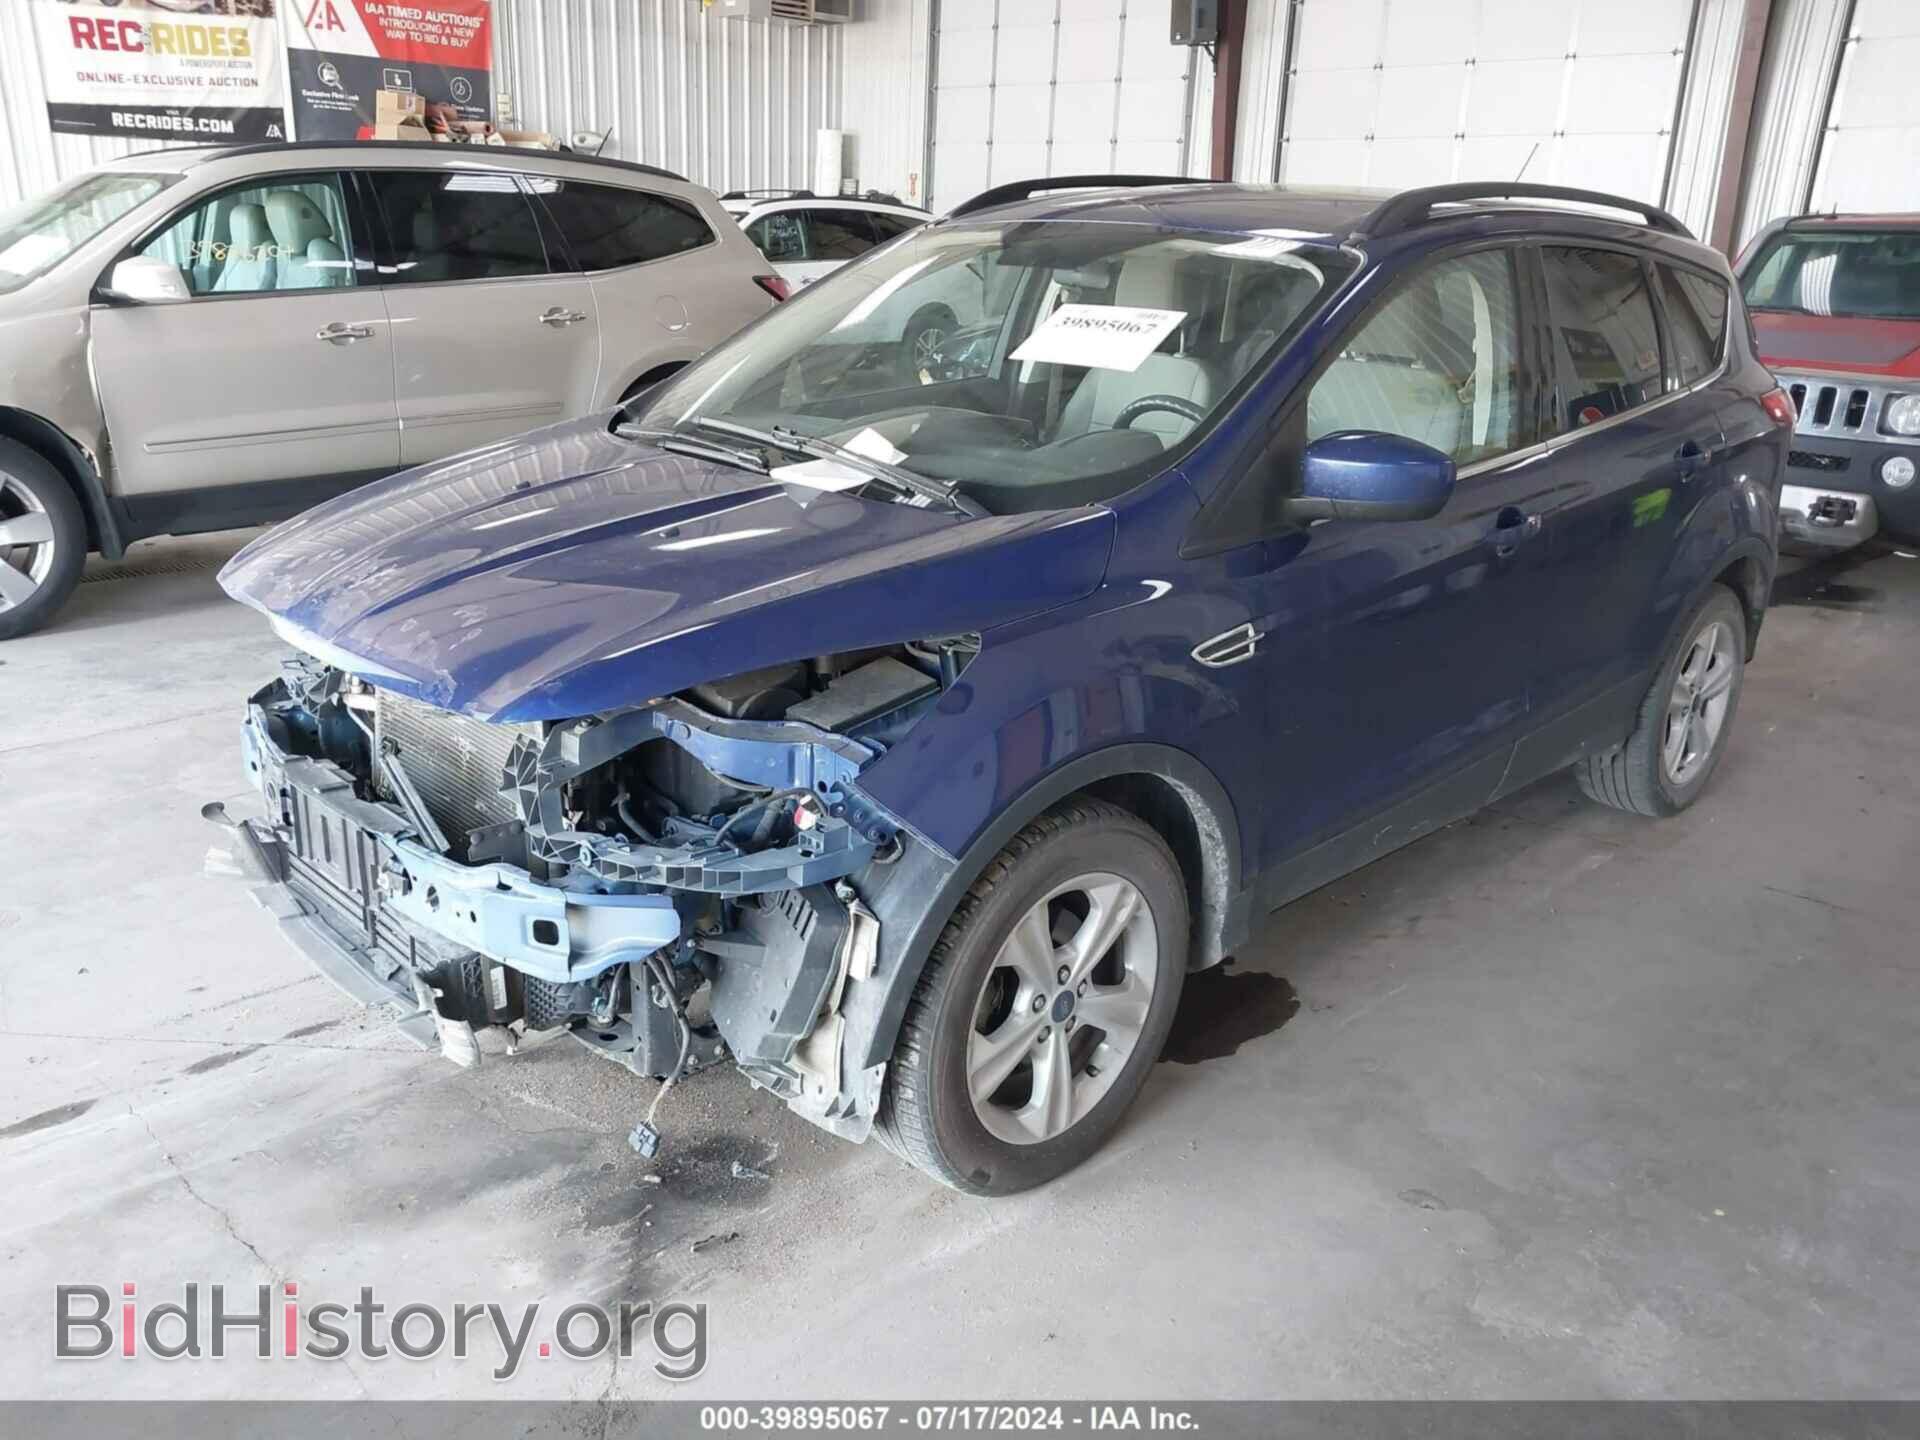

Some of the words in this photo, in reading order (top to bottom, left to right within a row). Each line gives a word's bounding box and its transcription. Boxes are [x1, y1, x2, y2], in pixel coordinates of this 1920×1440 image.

[365, 3, 384, 15] IAA
[386, 5, 422, 20] TIMED
[68, 16, 144, 53] REC
[150, 22, 252, 57] RIDES
[379, 17, 442, 34] INTRODUCING
[445, 27, 452, 35] A
[453, 28, 475, 39] NEW
[385, 29, 407, 41] WAY
[409, 32, 423, 42] TO
[450, 37, 470, 49] BUY
[76, 71, 203, 87] ONLINE-EXCLUSIVE
[209, 77, 259, 88] AUCTION
[111, 112, 234, 133] RECRIDES.COM
